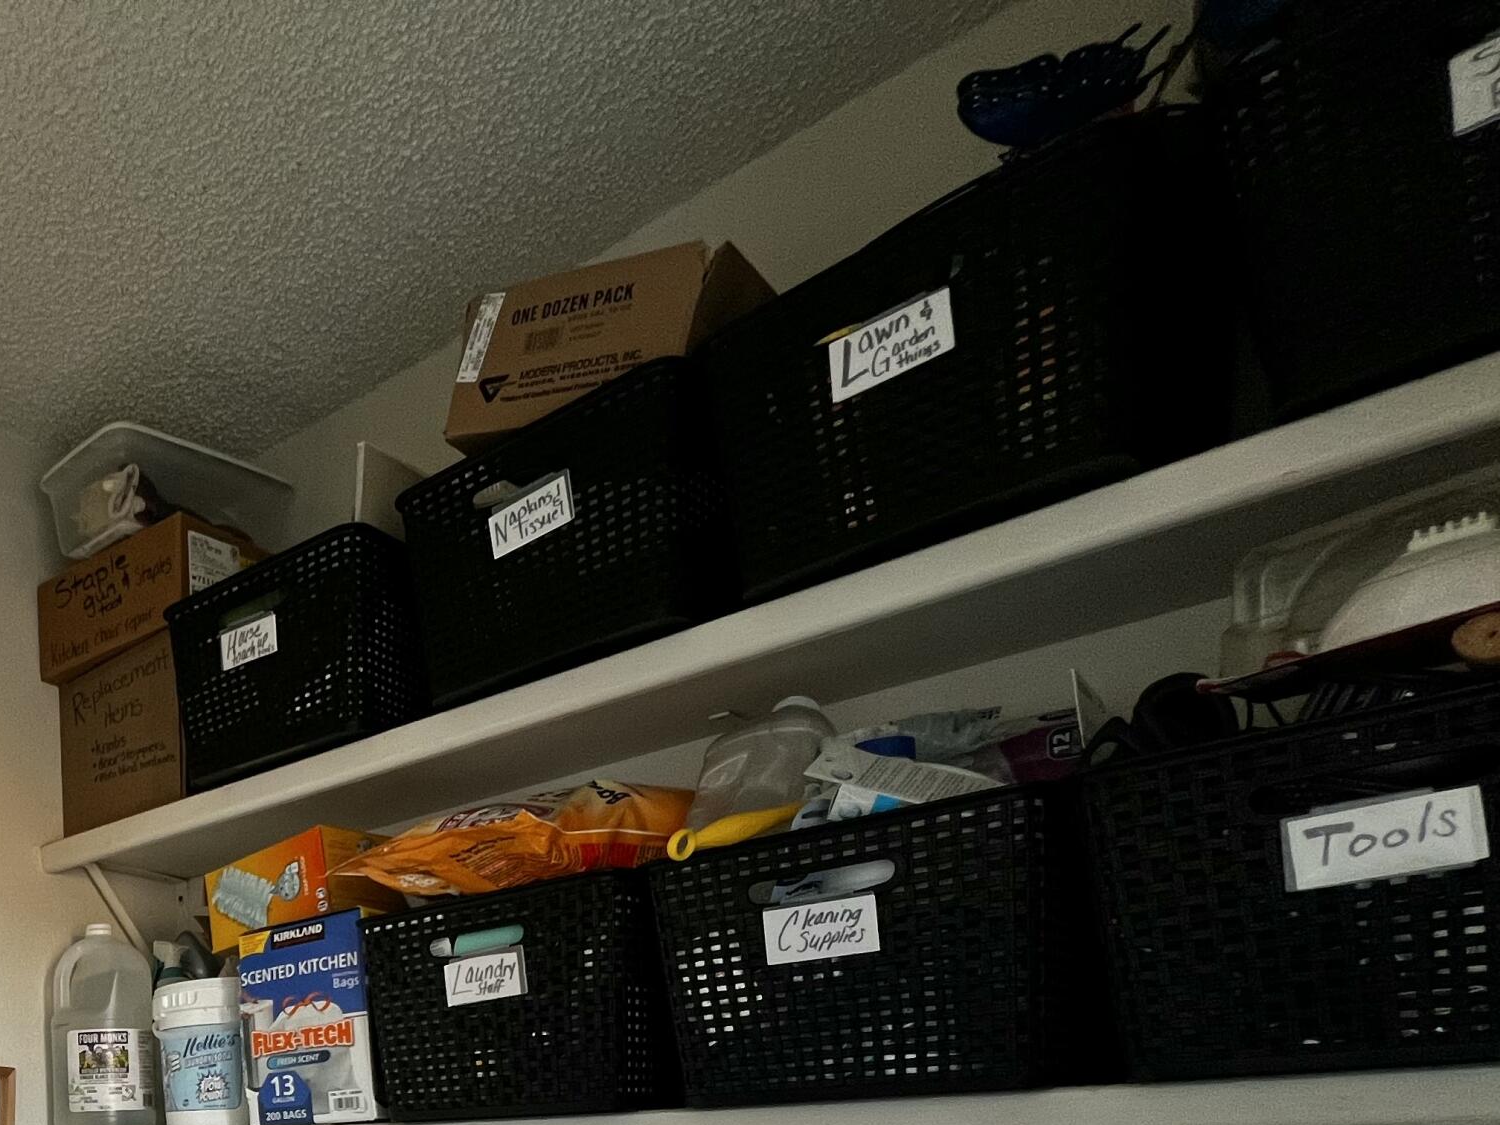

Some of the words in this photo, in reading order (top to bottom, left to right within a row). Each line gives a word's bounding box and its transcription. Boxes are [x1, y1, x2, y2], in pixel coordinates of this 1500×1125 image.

[511, 305, 538, 326] ONE
[541, 293, 589, 319] DOZEN
[592, 283, 636, 307] PACK
[841, 314, 909, 388] Lawn
[872, 326, 935, 377] Garden
[896, 340, 941, 368] things
[494, 491, 552, 546] Napkins
[55, 552, 129, 609] Staple
[83, 583, 116, 617] gun
[72, 648, 169, 726] Replacement
[1051, 731, 1070, 754] 12
[1303, 801, 1457, 866] Tools
[274, 924, 323, 943] KIRKLAND
[778, 909, 864, 952] Cleaning
[796, 927, 866, 953] Supplies
[241, 964, 295, 987] SCENTED
[299, 951, 358, 975] KITCHEN
[333, 976, 359, 989] Bags
[452, 958, 516, 995] Laundry
[79, 1033, 98, 1045] FOUR
[100, 1032, 128, 1044] MONKS
[183, 1033, 240, 1058] Nellie's
[251, 1019, 354, 1058] FLEX-TECH
[297, 1053, 319, 1063] SCENT
[270, 1074, 295, 1097] 13
[266, 1111, 281, 1122] 200
[283, 1109, 307, 1120] BAGS
